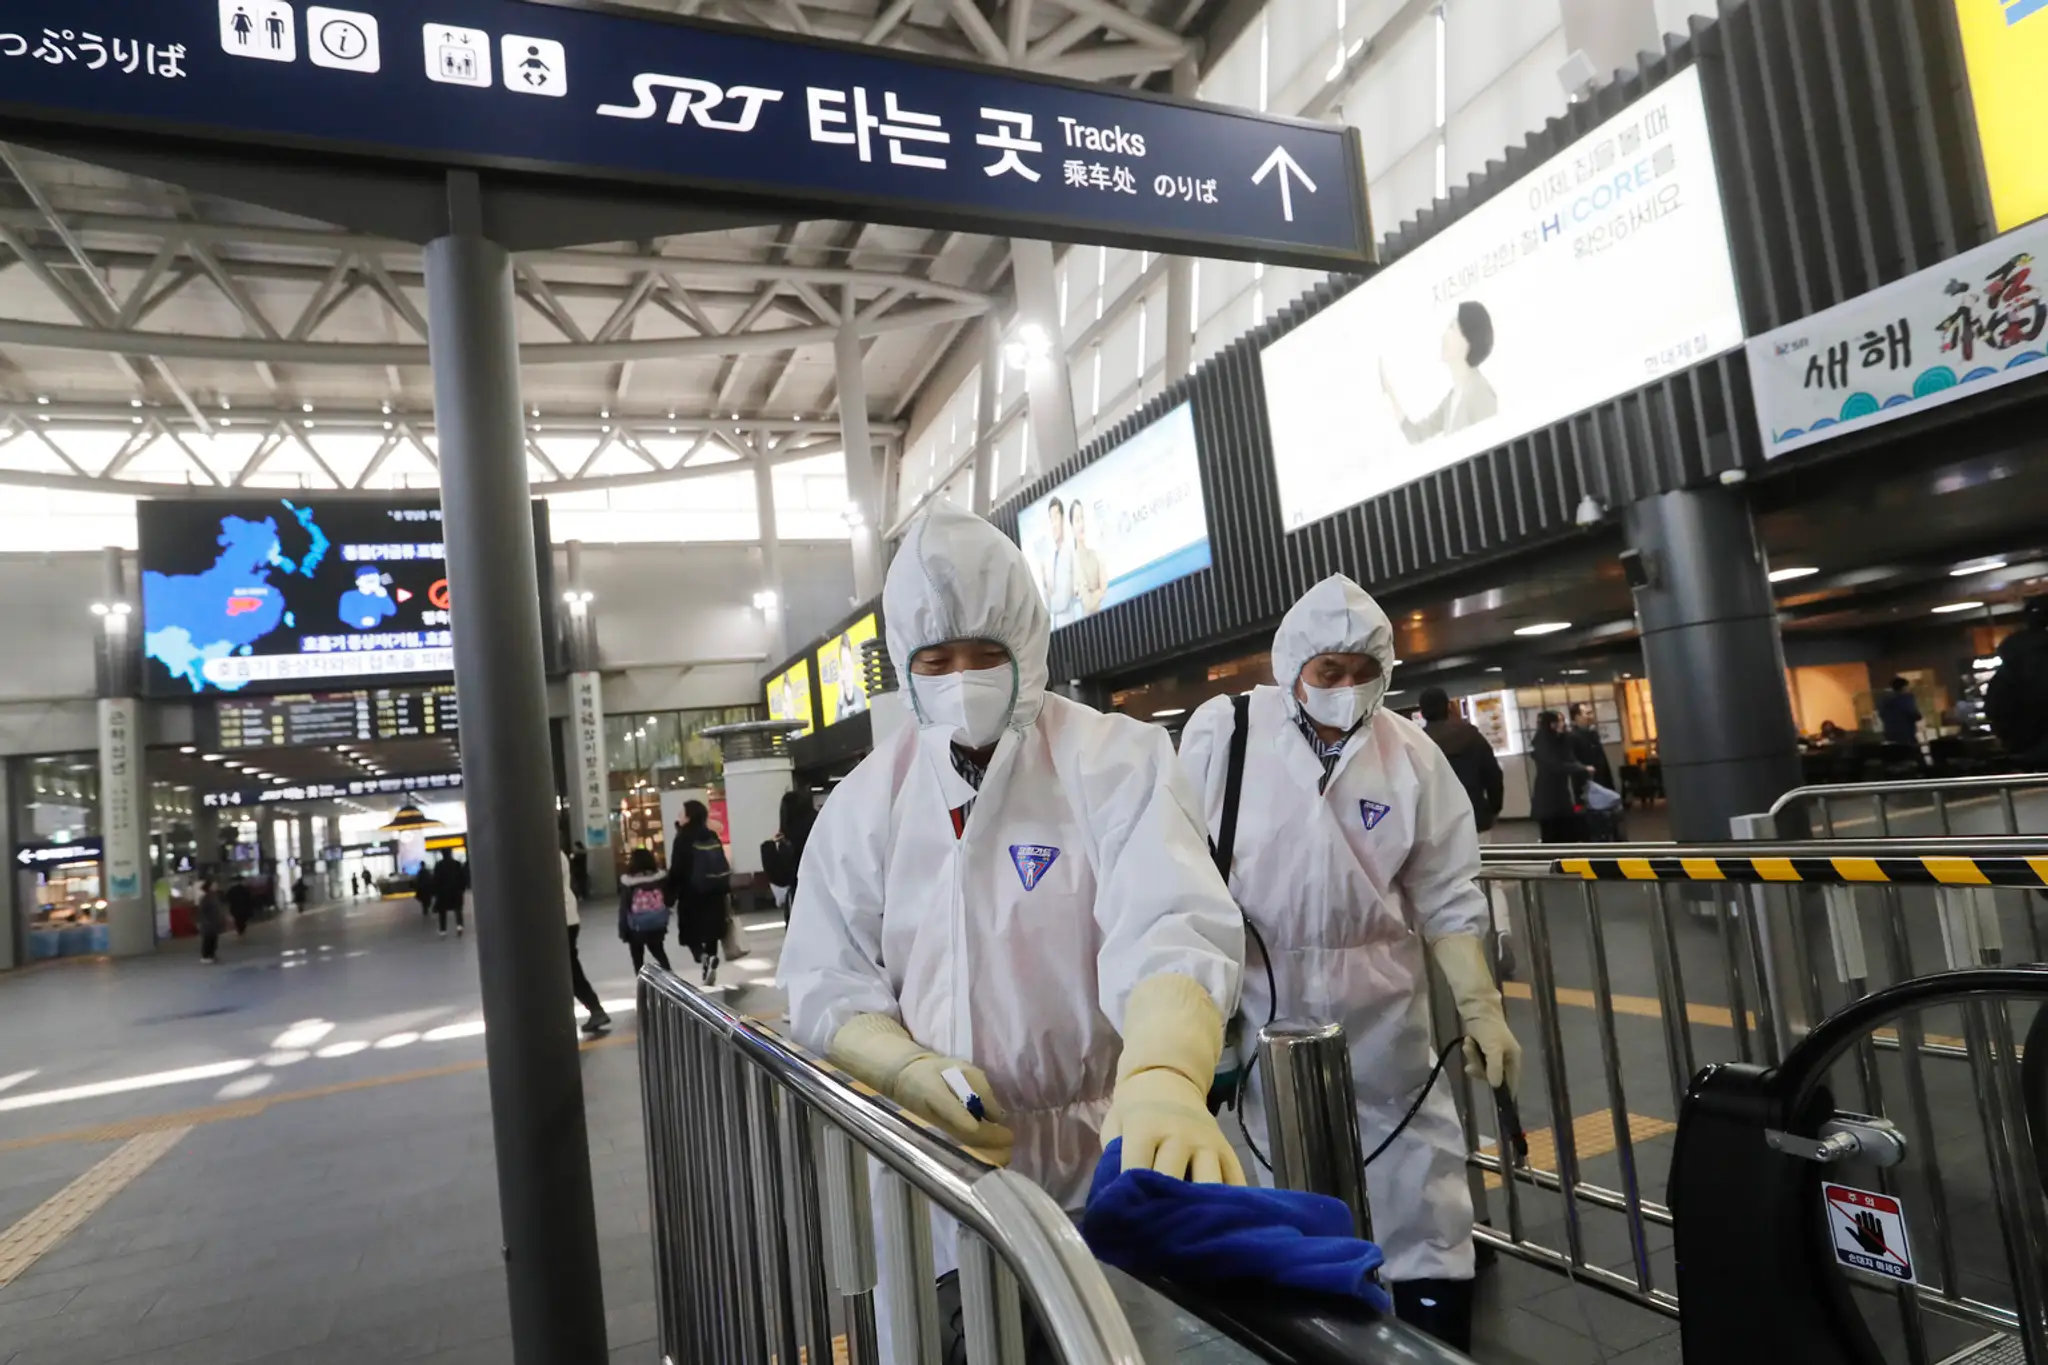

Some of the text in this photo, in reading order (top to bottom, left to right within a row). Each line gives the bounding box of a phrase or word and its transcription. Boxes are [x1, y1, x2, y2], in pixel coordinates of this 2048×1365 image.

[596, 73, 1043, 183] SRT 타는 곳
[1057, 116, 1146, 157] Tracks
[1063, 159, 1219, 204] 乘车处 のりば
[1804, 318, 1911, 390] 새해
